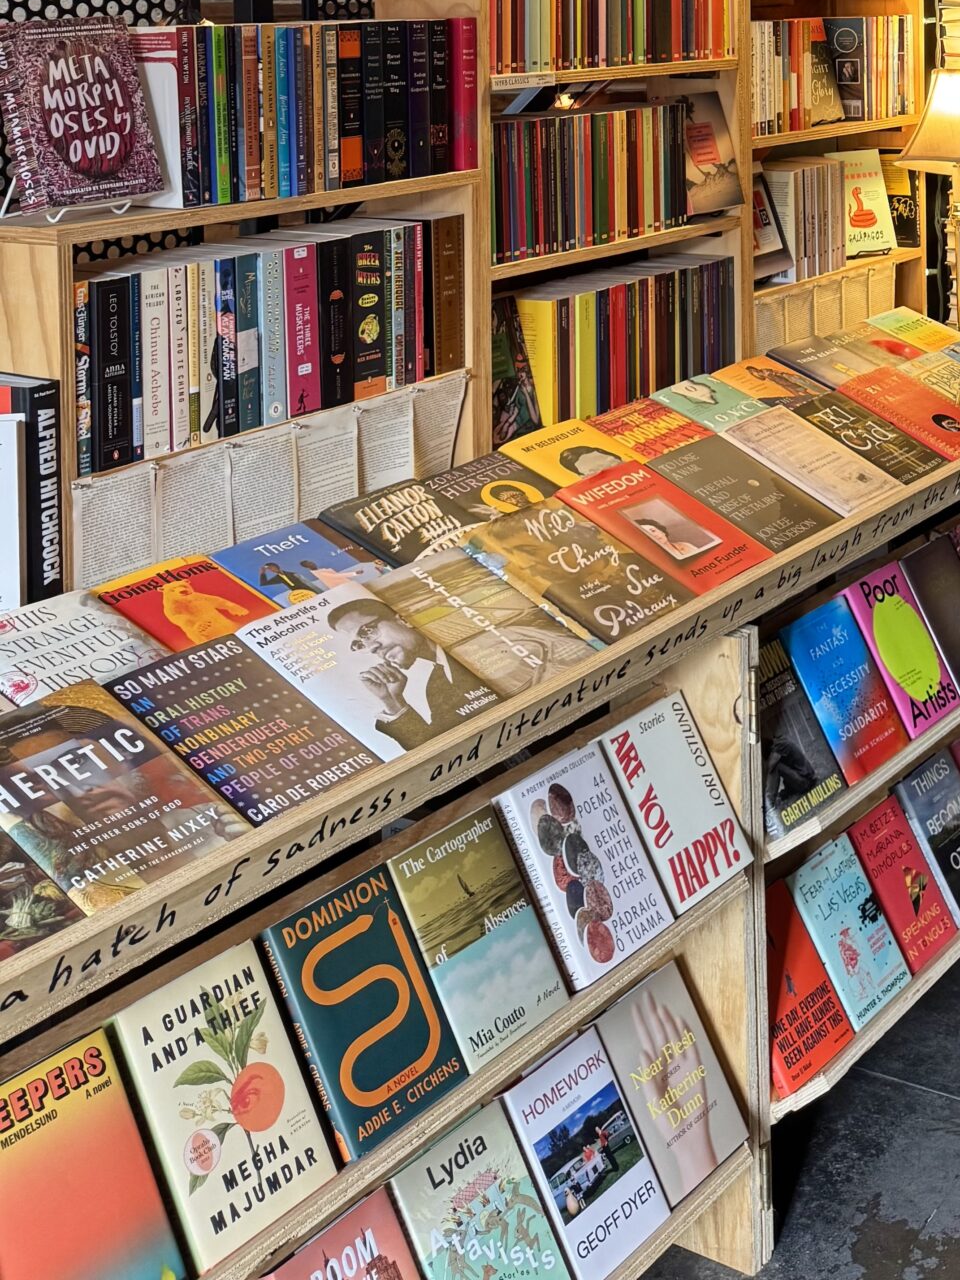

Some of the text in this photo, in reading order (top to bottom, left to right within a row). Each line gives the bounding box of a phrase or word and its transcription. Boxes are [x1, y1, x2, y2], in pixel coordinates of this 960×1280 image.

[42, 78, 124, 112] MORPH
[50, 54, 110, 89] META
[50, 107, 131, 139] OSES by
[3, 92, 39, 205] METAMORPHOSES
[68, 132, 120, 164] OVID
[356, 252, 380, 267] GREEK
[356, 271, 381, 286] MYTHS
[109, 293, 118, 357] LEO TOLSTOY
[295, 303, 304, 357] MUSKETEERS
[150, 316, 162, 418] Chinua Achebe
[37, 408, 61, 586] ALFRED HITCHCOCK
[352, 484, 429, 534] ELEANOR
[571, 468, 652, 507] WIFEDOM
[253, 533, 310, 559] Theft
[380, 502, 446, 545] CATTON
[769, 517, 817, 549] ANDERSON
[98, 559, 220, 606] Going Home
[689, 542, 750, 580] Anna Funder
[859, 574, 902, 609] Poor
[12, 629, 130, 677] EVENTFUL
[39, 645, 143, 692] HISTORY
[809, 628, 850, 661] FANTASY
[114, 681, 143, 700] SO
[144, 659, 191, 690] MANY
[189, 640, 243, 670] STARS
[464, 685, 492, 701] Mark
[821, 661, 872, 700] NECESSITY
[131, 696, 156, 715] AN
[145, 677, 248, 729] ORAL HISTORY
[456, 692, 499, 719] Whitaker
[838, 699, 889, 742] SOLIDARITY
[909, 678, 958, 729] Artists
[0, 989, 29, 1012] a
[203, 857, 250, 907] of
[262, 786, 408, 877] sadness,
[429, 734, 483, 783] and
[496, 658, 632, 750] literature
[644, 616, 709, 666] sends
[722, 596, 743, 621] up
[754, 587, 766, 600] a
[777, 564, 802, 591] big
[811, 526, 864, 572] laugh
[873, 501, 916, 538] from
[923, 480, 948, 508] the
[206, 725, 316, 786] AND TWO-SPIRIT
[220, 731, 348, 800] PEOPLE OF COLOR
[247, 753, 374, 823] CARO DE ROBERTIS
[610, 729, 674, 849] ARE YOU
[780, 772, 842, 827] GARTH MULLINS
[911, 757, 950, 798] THINGS
[576, 788, 613, 819] POEMS
[70, 806, 221, 890] CATHERINE NIXEY
[399, 815, 493, 880] The Cartographer
[595, 818, 626, 849] BEING
[604, 836, 633, 863] WITH
[611, 852, 640, 879] EACH
[612, 868, 647, 899] OTHER
[668, 817, 742, 904] HAPPY?
[282, 872, 388, 949] DOMINION
[901, 902, 942, 943] SPEAKING
[141, 965, 255, 1047] A GUARDIAN
[468, 1003, 526, 1054] Mia Couto
[783, 1046, 803, 1071] BEEN
[800, 1023, 828, 1056] AGAINST
[826, 1008, 843, 1032] THIS
[521, 1049, 606, 1126] HOMEWORK
[645, 1062, 707, 1122] Katherine
[221, 1134, 290, 1193] MEGHA
[425, 1132, 488, 1191] Lydia
[209, 1145, 318, 1236] MAJUMDAR
[576, 1177, 657, 1262] GEOFF DYER
